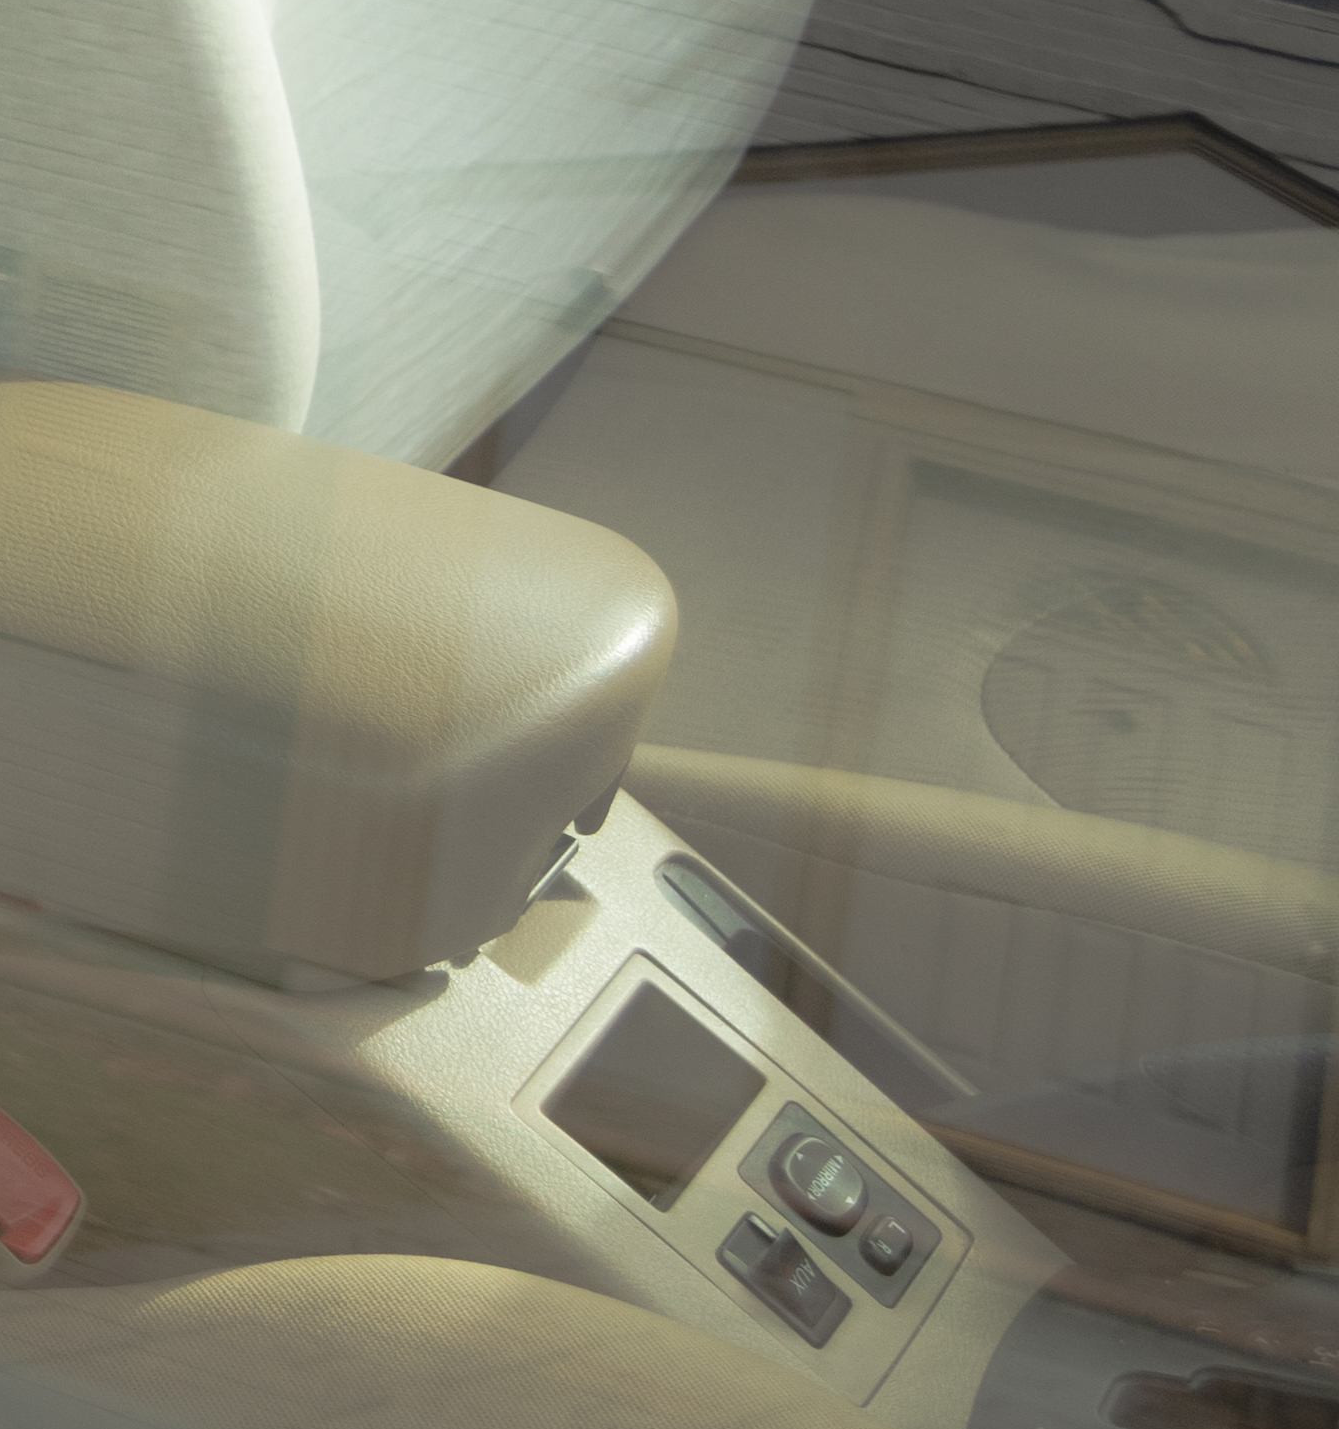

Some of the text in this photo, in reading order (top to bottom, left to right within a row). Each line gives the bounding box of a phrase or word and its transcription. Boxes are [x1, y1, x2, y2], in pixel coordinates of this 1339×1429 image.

[807, 1157, 842, 1198] MIRROR
[888, 1220, 906, 1234] L
[876, 1239, 893, 1255] R
[789, 1258, 816, 1296] AUX
